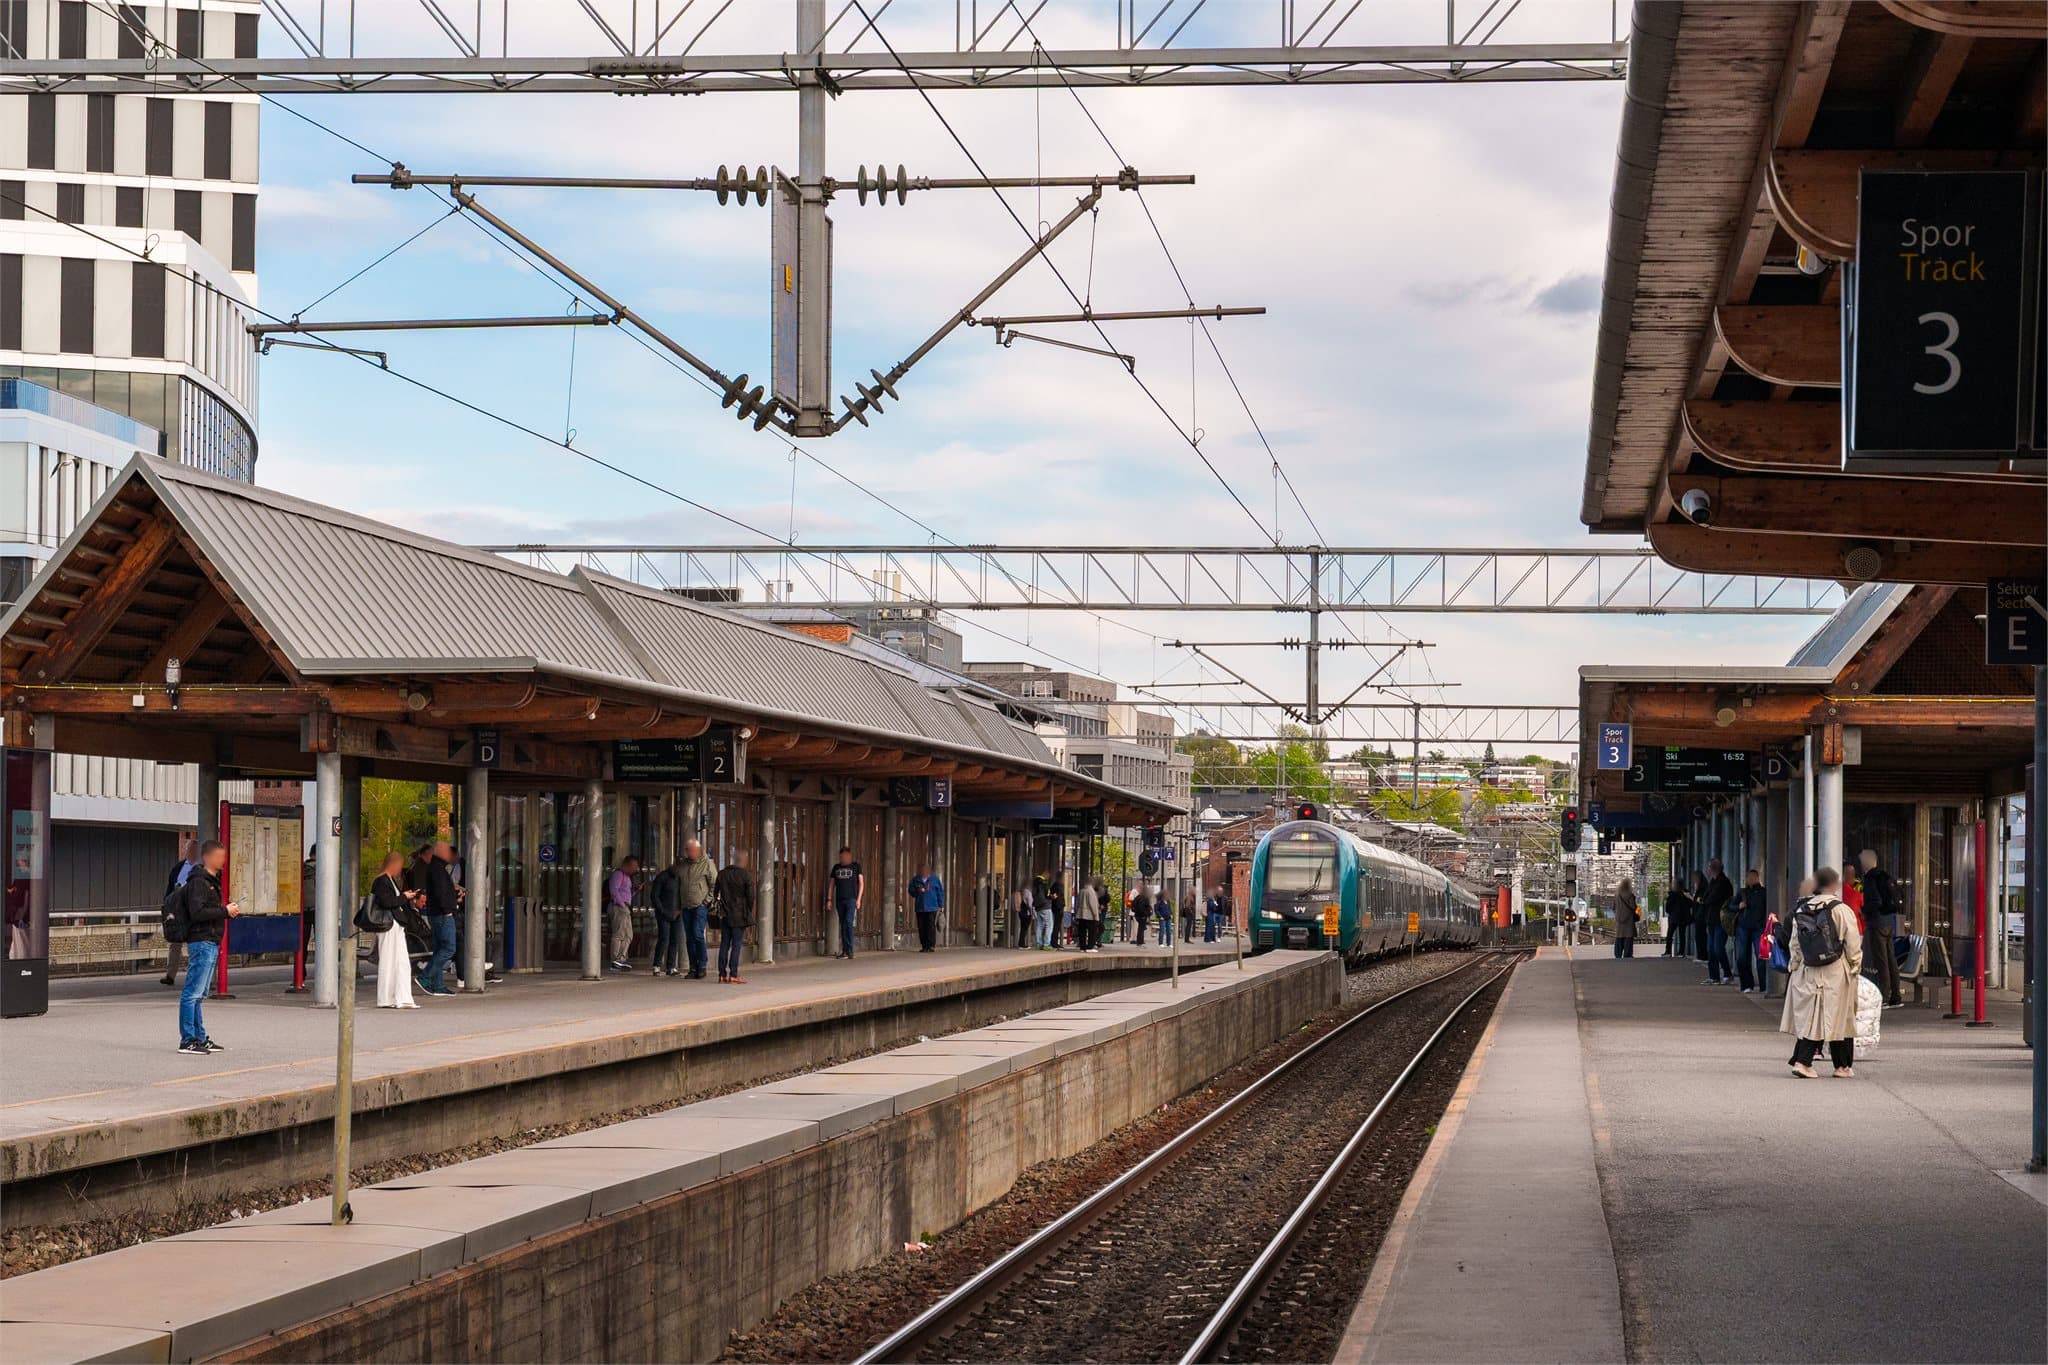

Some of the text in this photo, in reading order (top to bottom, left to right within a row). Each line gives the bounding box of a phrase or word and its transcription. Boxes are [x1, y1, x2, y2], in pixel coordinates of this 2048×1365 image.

[1901, 218, 1976, 254] Spor
[1899, 252, 1985, 281] Track
[1913, 311, 1961, 394] 3
[1997, 582, 2039, 595] Sektor
[1997, 598, 2032, 609] Secto
[2008, 616, 2027, 650] E
[1605, 728, 1623, 736] Spor
[481, 745, 494, 761] D
[1609, 746, 1619, 764] 3
[1665, 752, 1745, 761] Ski 16:52
[713, 756, 725, 773] 2
[1769, 759, 1780, 775] D
[1634, 764, 1645, 782] 3
[937, 792, 944, 802] 2
[1593, 812, 1599, 822] 3
[1693, 806, 1701, 817] C
[1092, 819, 1099, 830] 2
[1610, 826, 1617, 837] 3
[1153, 837, 1159, 845] 2
[1603, 846, 1608, 854] 3
